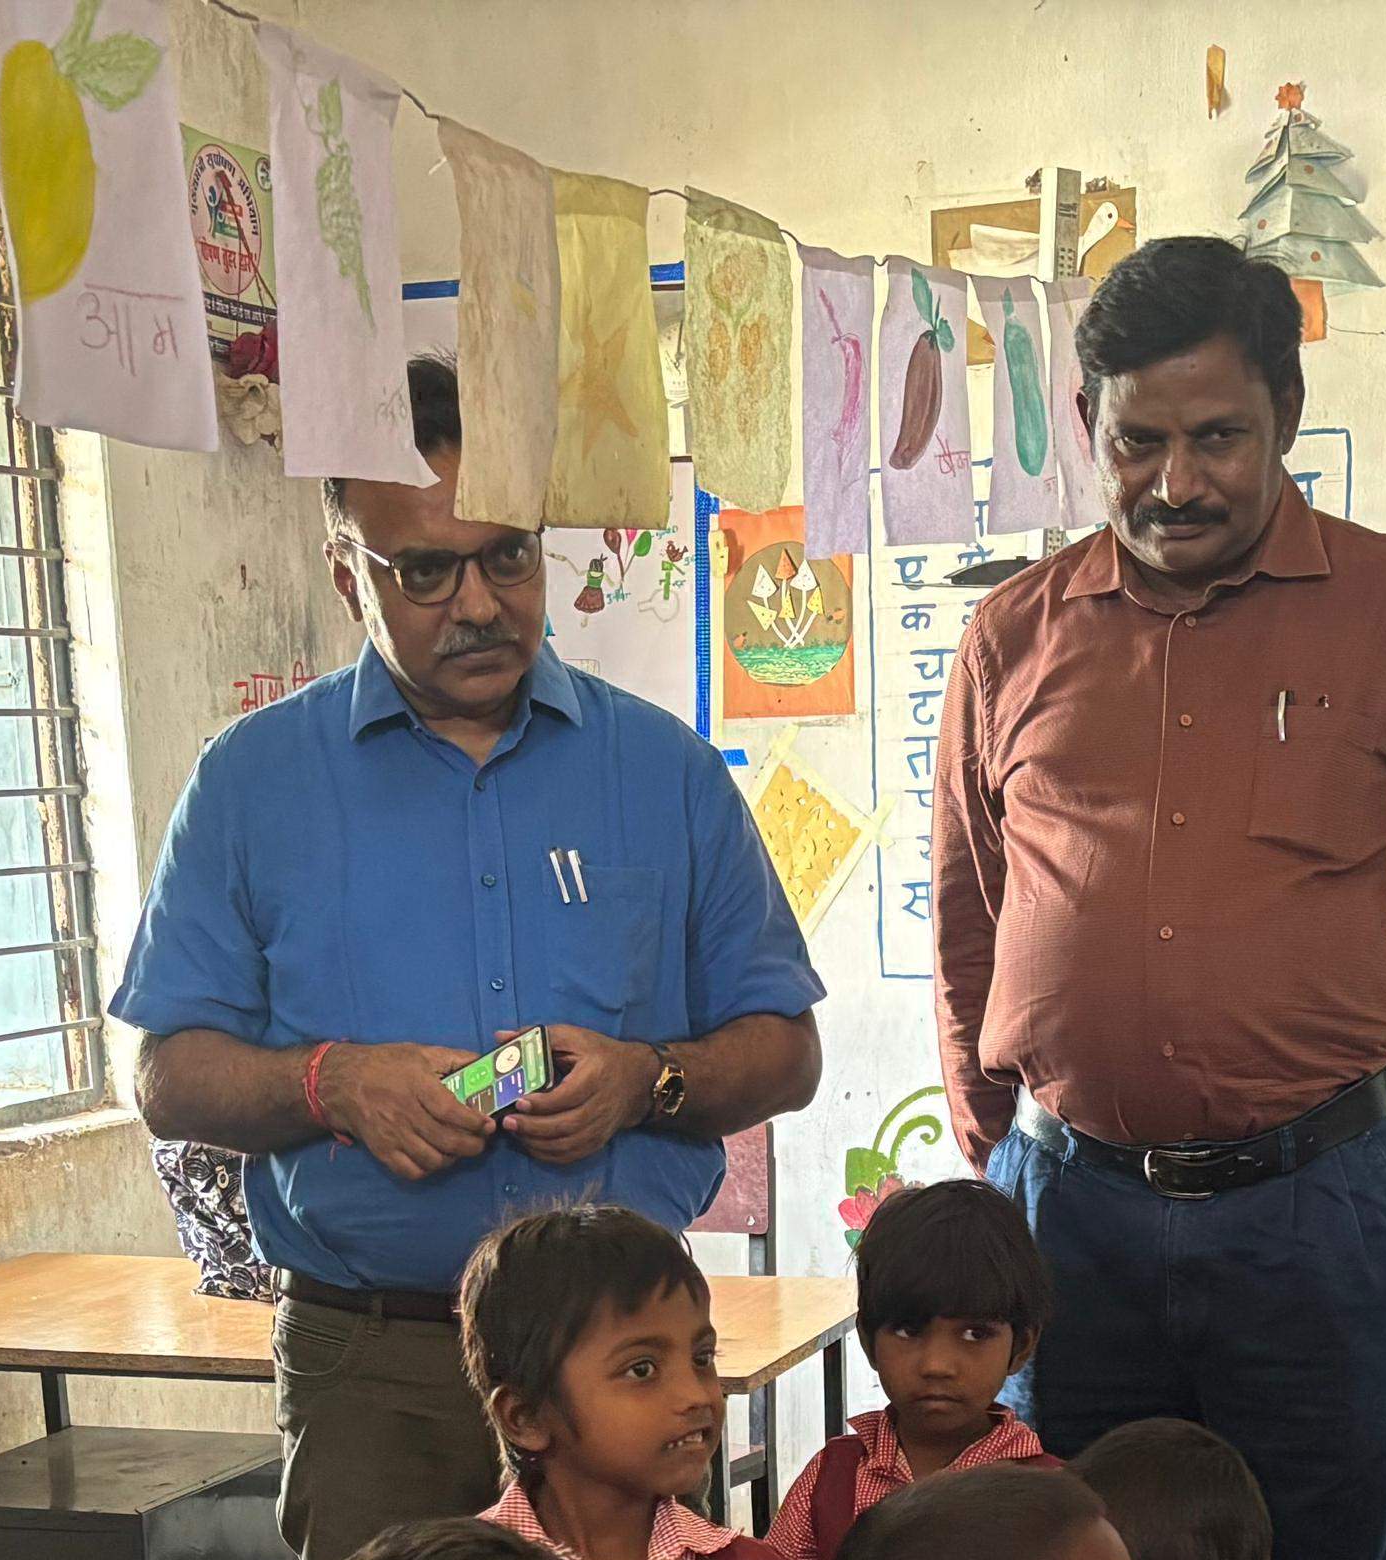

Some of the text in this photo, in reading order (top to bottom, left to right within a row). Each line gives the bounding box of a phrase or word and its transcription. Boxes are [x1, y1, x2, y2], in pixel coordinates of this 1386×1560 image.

[894, 555, 928, 590] ए
[901, 603, 936, 631] क
[910, 648, 958, 680] च
[909, 690, 942, 725] ट
[904, 736, 940, 779] त
[902, 881, 931, 920] स
